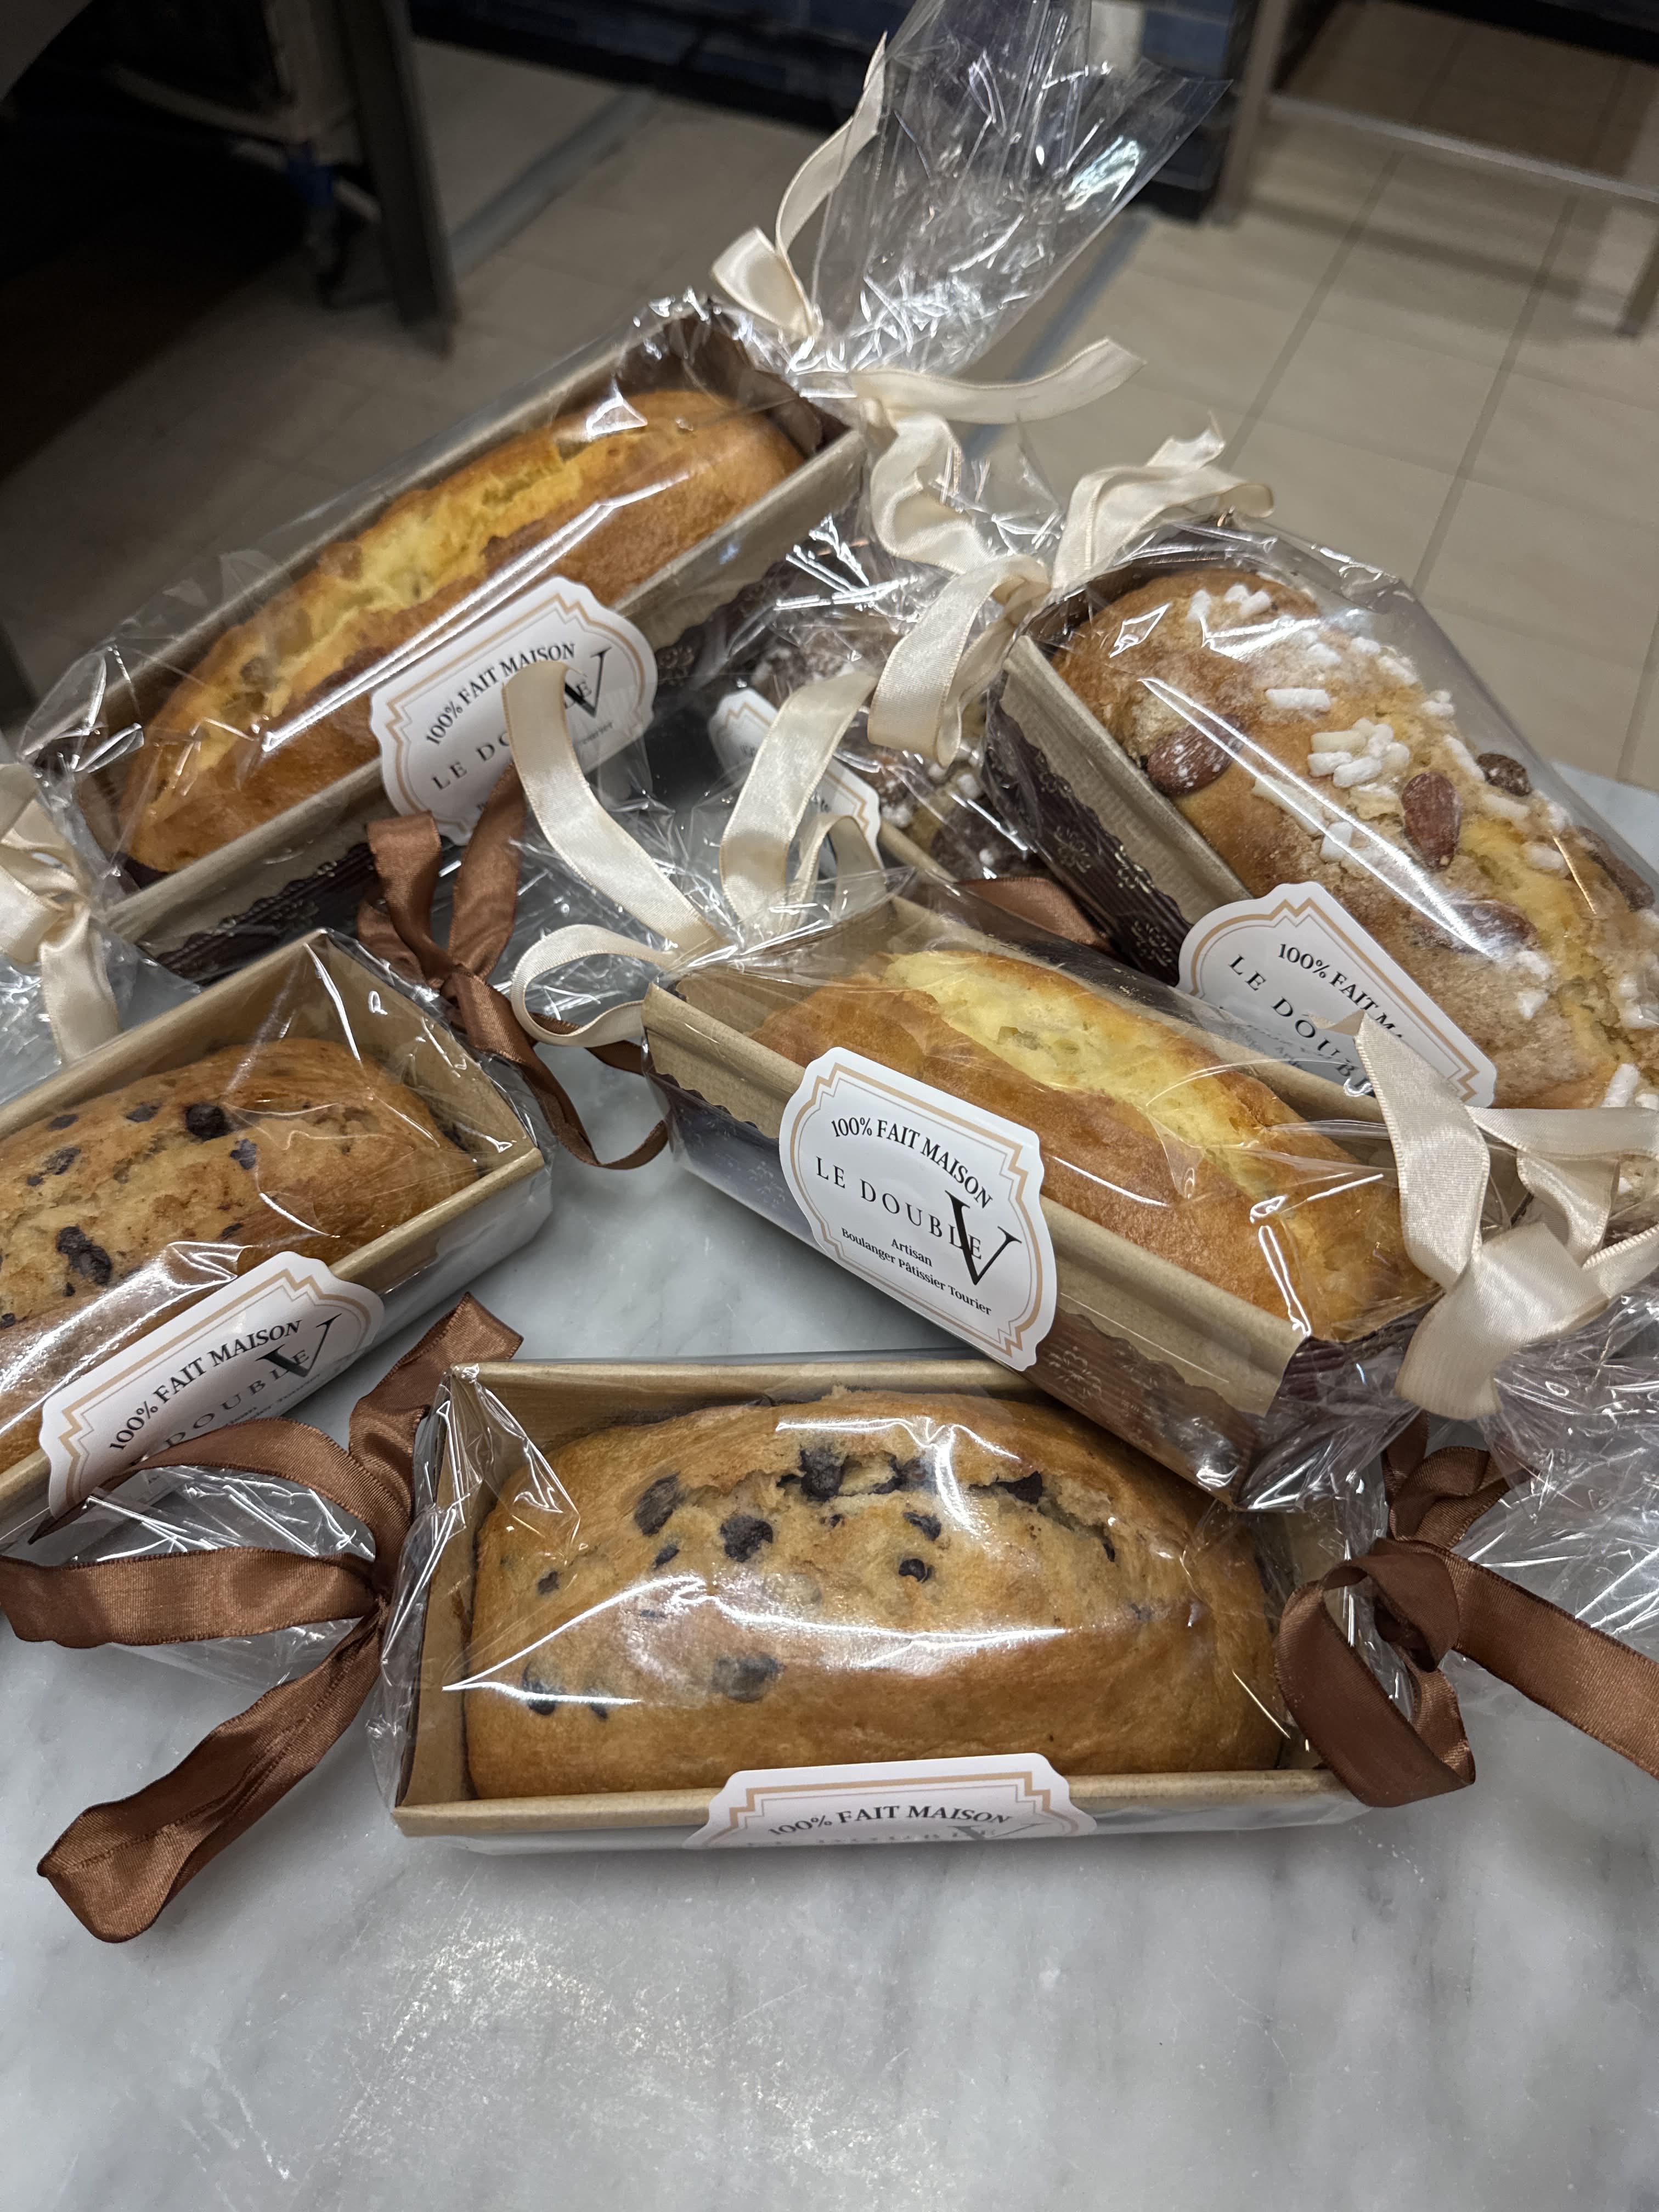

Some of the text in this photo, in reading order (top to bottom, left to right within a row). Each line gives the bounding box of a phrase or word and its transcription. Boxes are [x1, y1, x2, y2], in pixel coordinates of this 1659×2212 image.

[426, 642, 576, 746] 100% FAIT MAISON
[431, 761, 467, 790] LE
[1228, 954, 1266, 991] LE
[1278, 943, 1379, 1011] 100% FAIT
[831, 1116, 994, 1209] 100% FAIT MAISON
[815, 1156, 1023, 1286] LE DOUBLE V
[890, 1238, 933, 1267] Artisan
[841, 1227, 992, 1316] Boulanger Pâtissier Tourier
[255, 1312, 342, 1378] V
[110, 1319, 303, 1451] 100% FAIT MAISON
[768, 1805, 1014, 1835] 100% FAIT MAISON
